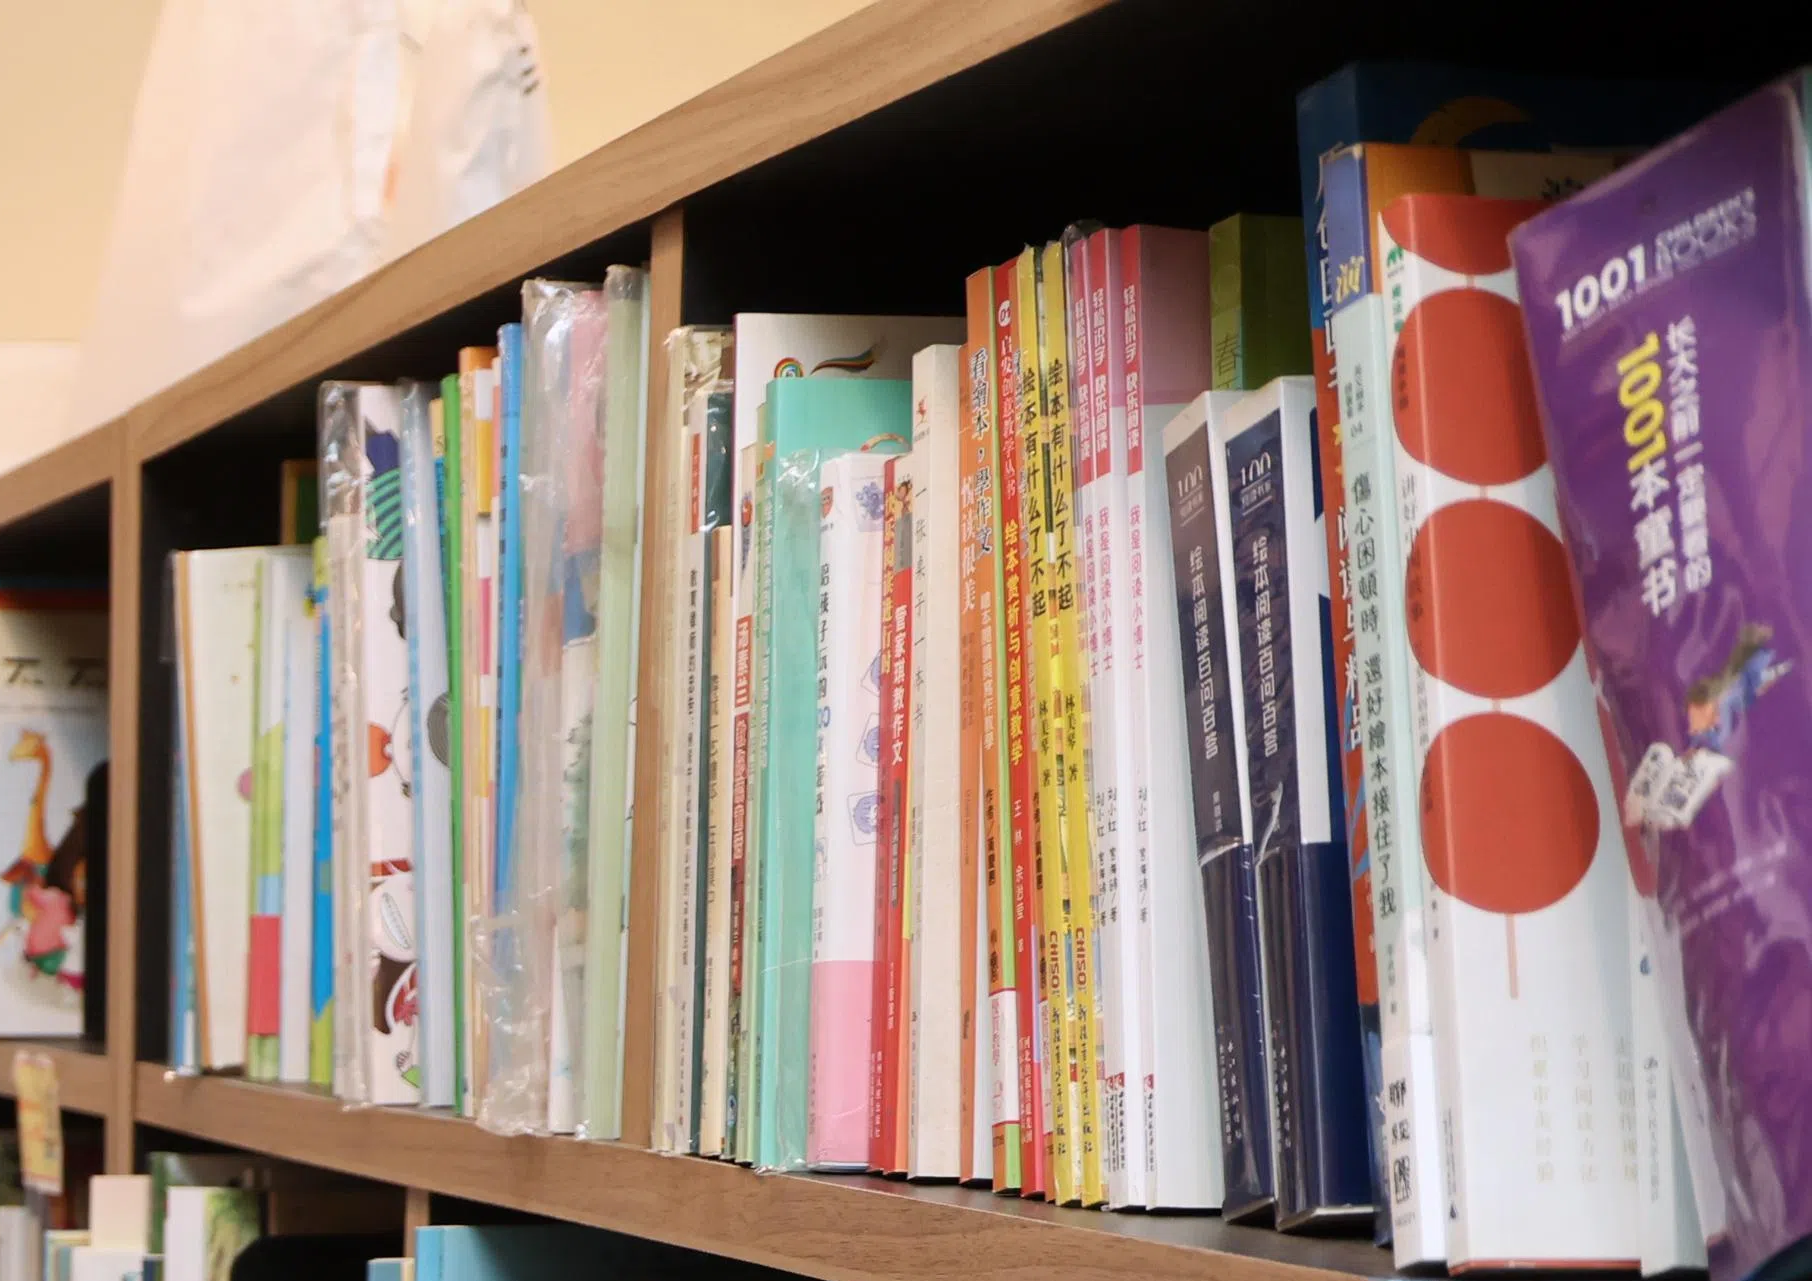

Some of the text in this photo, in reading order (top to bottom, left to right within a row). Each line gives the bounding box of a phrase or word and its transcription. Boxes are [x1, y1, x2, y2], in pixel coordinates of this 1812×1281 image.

[1555, 244, 1646, 331] 1001
[1021, 366, 1047, 618] 绘本有什么了不起
[1049, 358, 1074, 613] 绘本有什么了不起
[1617, 331, 1679, 617] 1001本童书
[1667, 315, 1713, 594] 长大之前一定要看的
[1189, 545, 1219, 760] 绘本阅读百问百答
[1253, 534, 1279, 758] 绘本阅读百问百答
